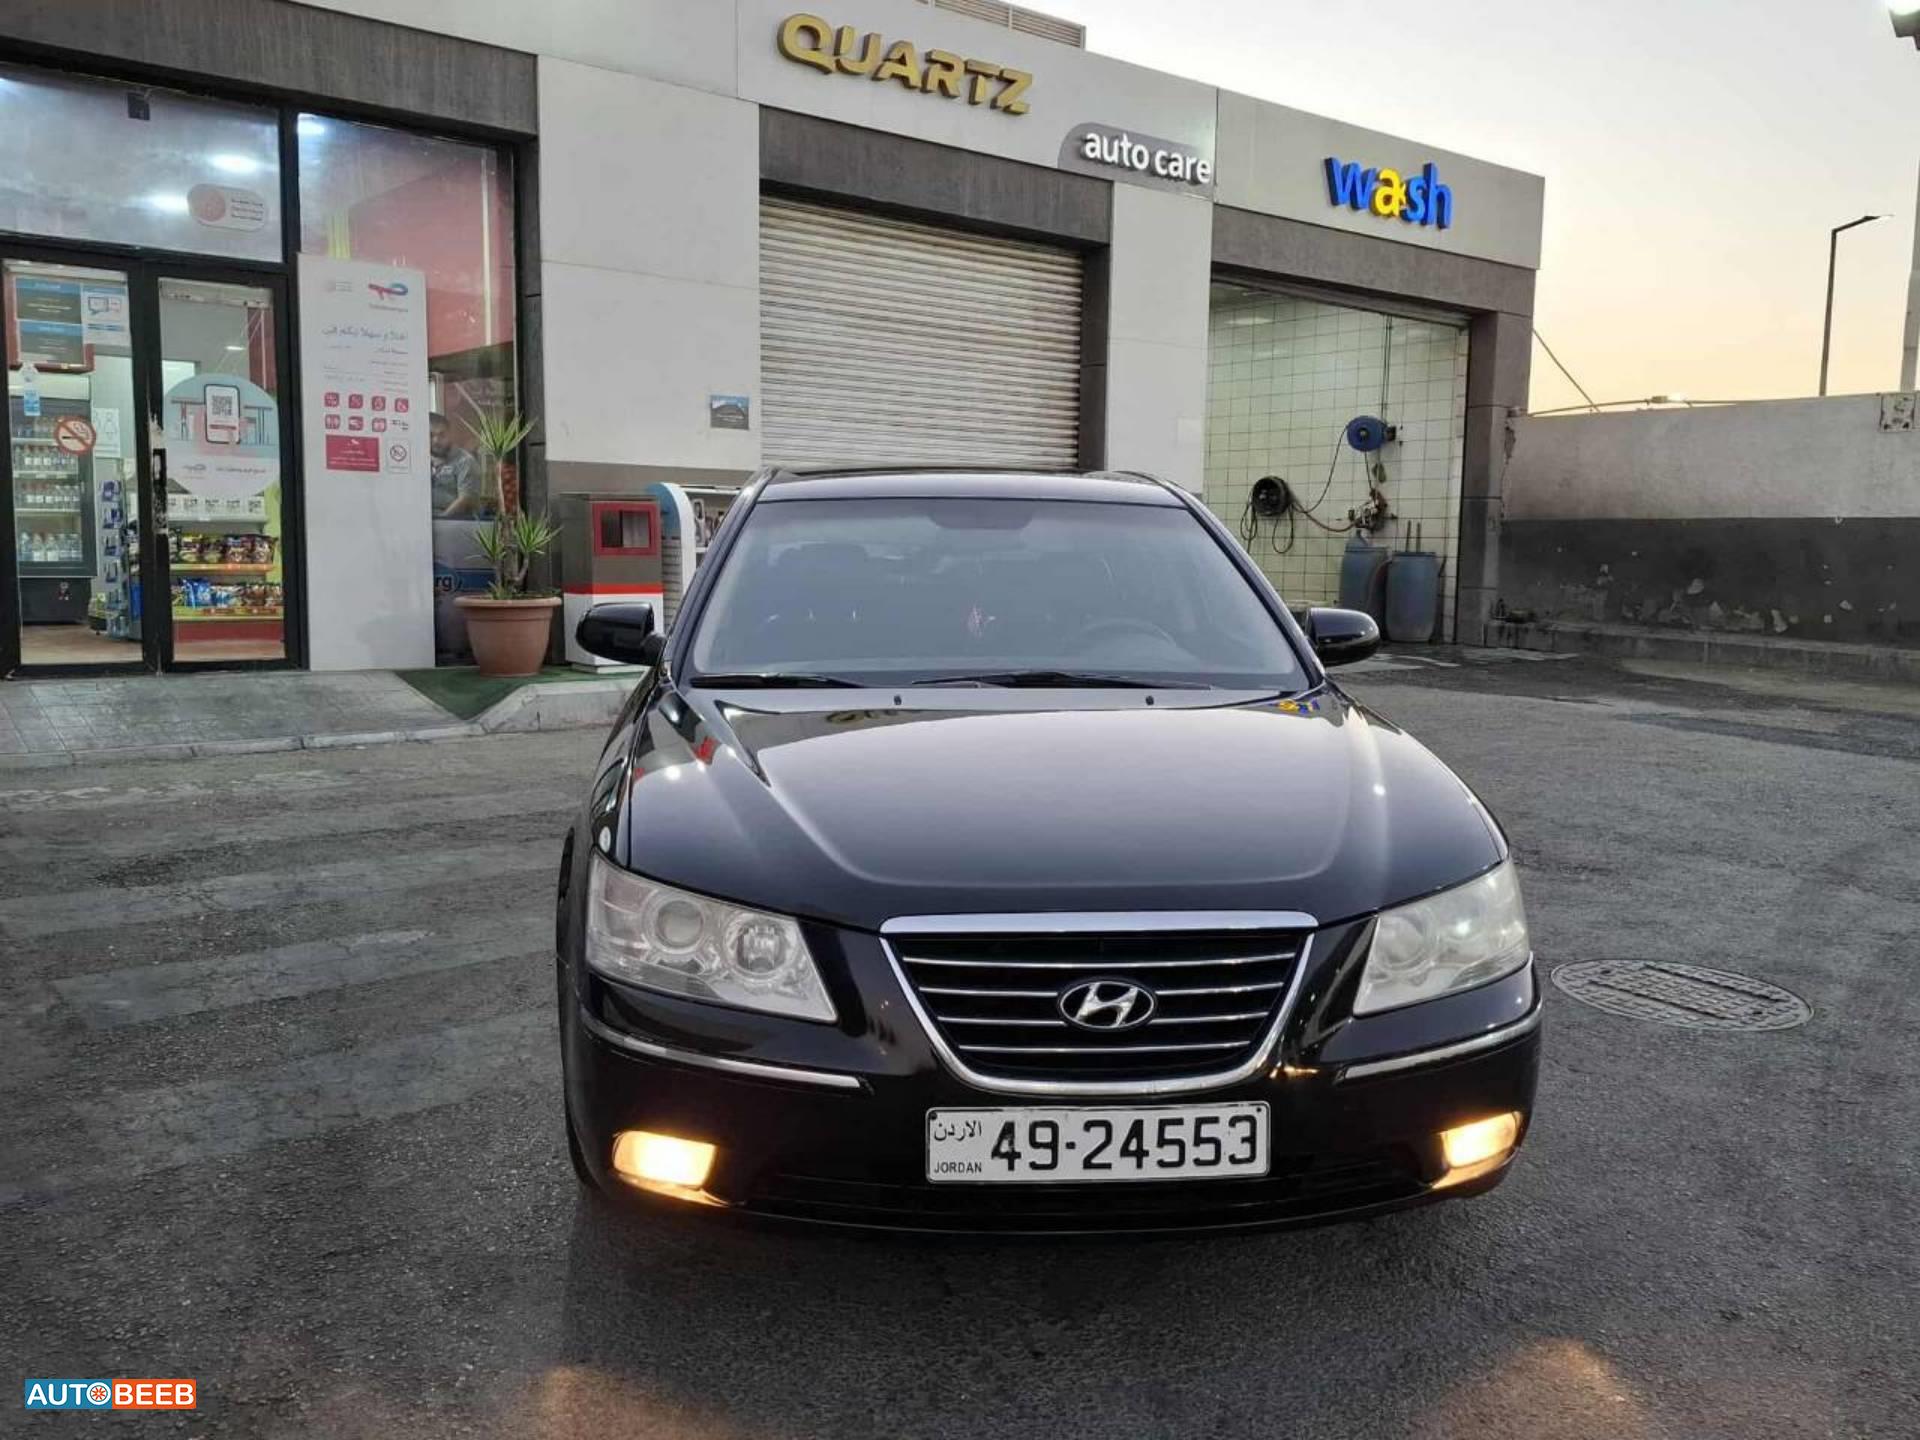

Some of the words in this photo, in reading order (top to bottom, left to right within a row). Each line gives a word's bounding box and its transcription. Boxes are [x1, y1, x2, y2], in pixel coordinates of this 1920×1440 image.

[777, 13, 1032, 115] QUARTZ
[1082, 131, 1150, 174] auto
[1154, 149, 1212, 185] care
[1324, 157, 1452, 229] wash
[934, 1162, 982, 1173] JORDAN
[991, 1114, 1258, 1172] 49-24553
